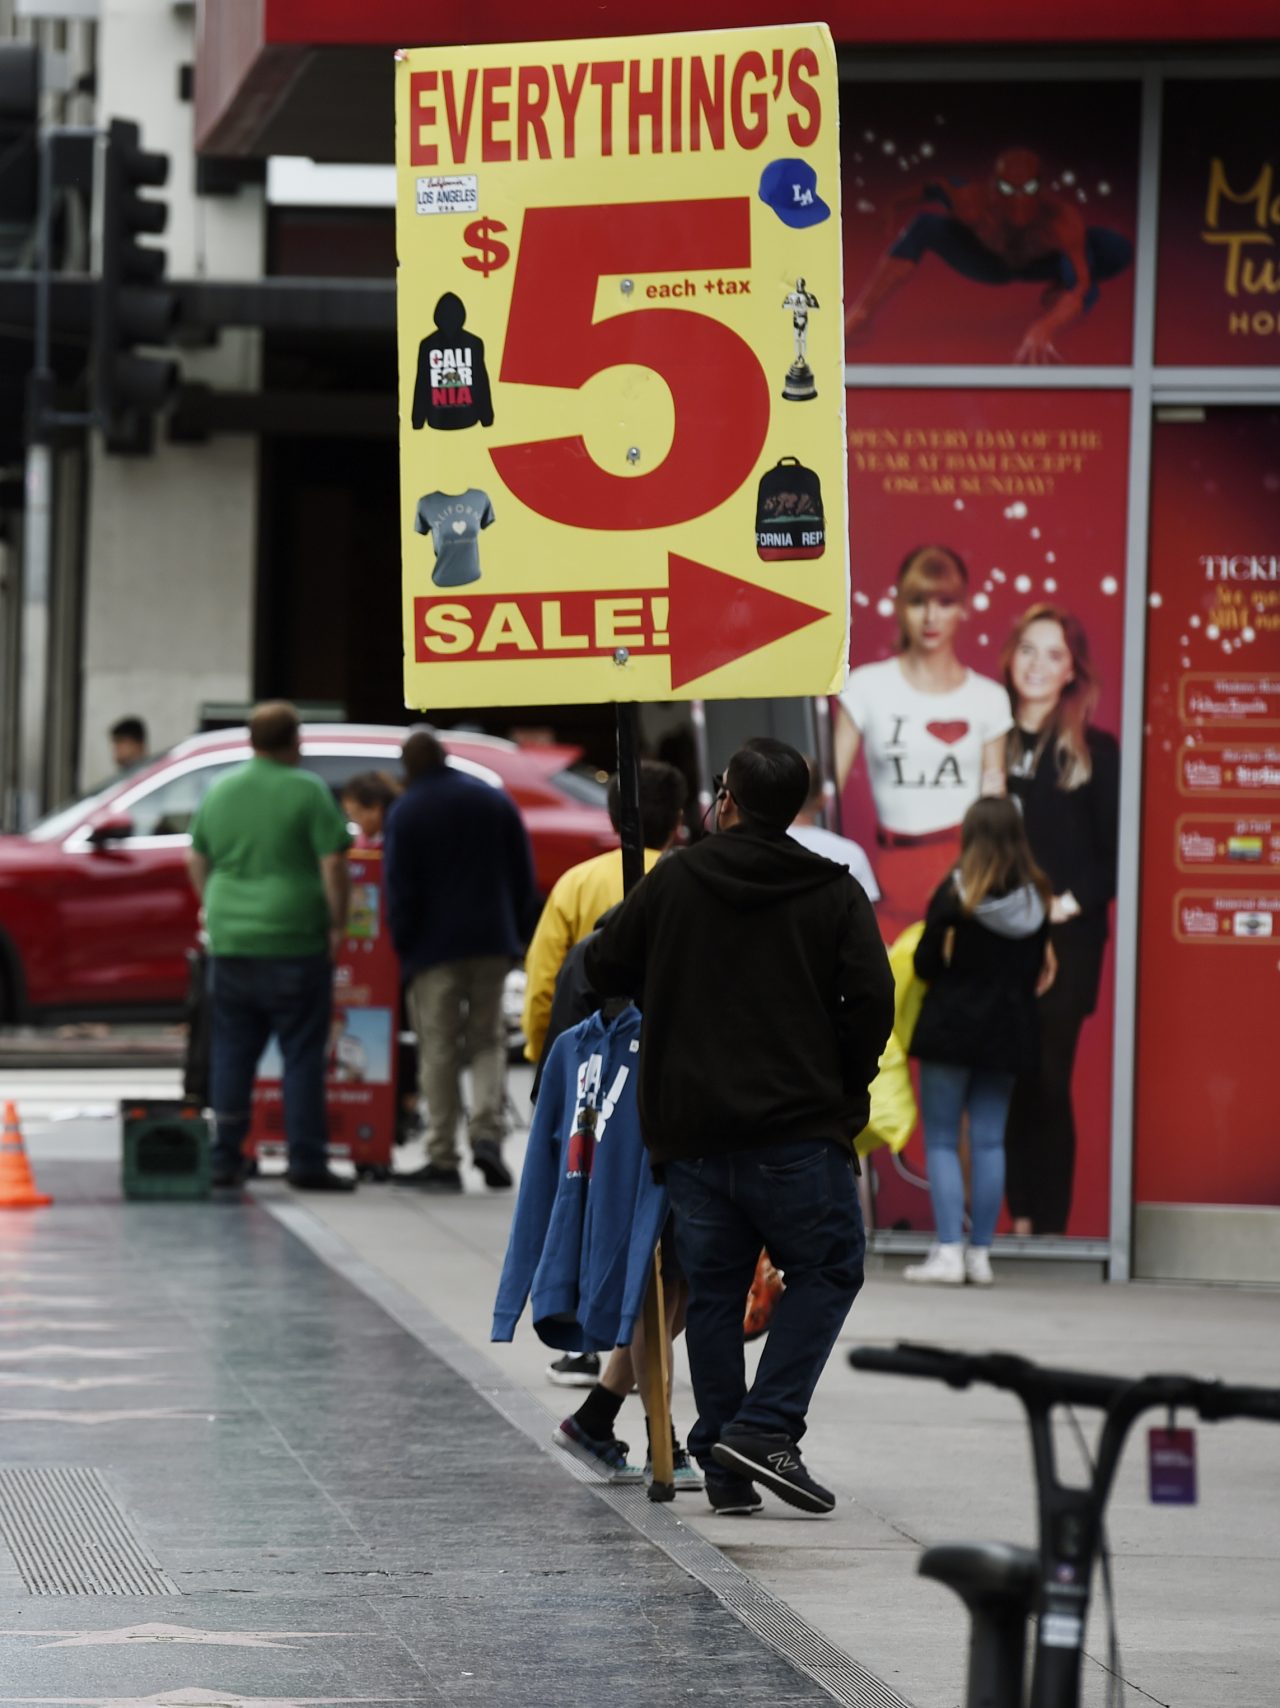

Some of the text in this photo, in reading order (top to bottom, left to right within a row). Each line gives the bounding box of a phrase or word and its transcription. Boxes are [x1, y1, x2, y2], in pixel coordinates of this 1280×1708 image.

[410, 47, 821, 167] EVERYTHING'S
[417, 188, 477, 204] LOS ANGELES
[792, 184, 814, 207] LA
[646, 277, 752, 299] each +tax
[429, 347, 472, 369] CALI
[461, 196, 771, 532] $ 5
[431, 386, 474, 408] NIA
[903, 429, 969, 449] EVERY
[975, 429, 1017, 449] DAY
[1021, 429, 1051, 449] OF
[1057, 429, 1102, 450] THE
[855, 452, 911, 472] YEAR
[917, 453, 941, 472] AT
[1001, 453, 1084, 473] EXCEPT
[883, 475, 956, 495] OSCAR
[802, 531, 825, 545] REP
[423, 596, 670, 655] SALE!
[886, 714, 908, 748] I
[886, 752, 967, 788] LA
